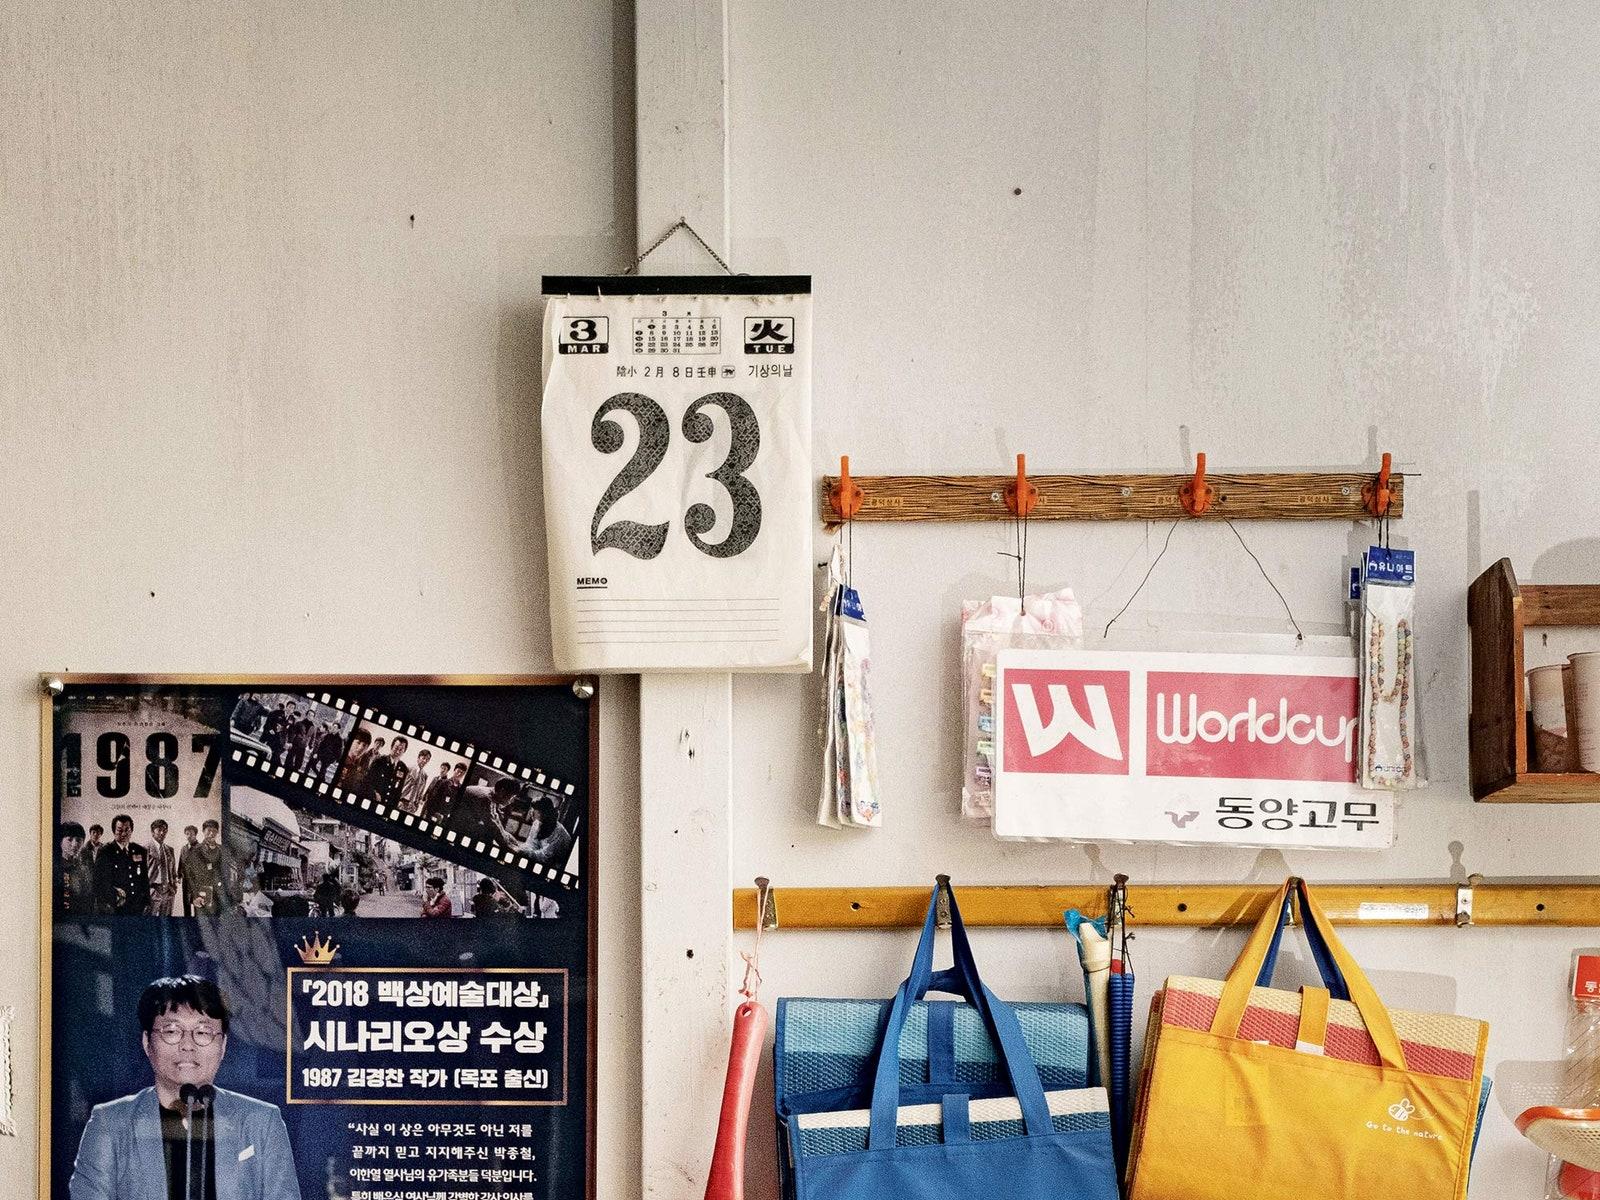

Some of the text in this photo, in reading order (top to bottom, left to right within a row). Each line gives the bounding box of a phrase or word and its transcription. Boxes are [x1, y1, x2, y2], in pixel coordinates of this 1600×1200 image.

[570, 319, 597, 341] 3
[750, 319, 789, 341] 火
[567, 345, 601, 353] MAR
[753, 345, 786, 353] TUE
[748, 365, 793, 378] 기상의날
[591, 391, 762, 561] 23
[576, 577, 608, 586] MEMO
[61, 732, 222, 798] 1987
[1216, 796, 1380, 831] 동양고무
[378, 981, 549, 1009] 백상예술대상』
[303, 1020, 548, 1054] 시나리오상 수상
[302, 1068, 342, 1088] 1987
[347, 1068, 405, 1088] 김경찬
[410, 1069, 447, 1089] 작가
[384, 1123, 396, 1137] 이
[400, 1123, 424, 1137] 상은
[427, 1123, 476, 1137] 아무것도
[480, 1124, 504, 1137] 아닌
[508, 1124, 533, 1138] 저를
[1366, 1121, 1379, 1130] Go
[1396, 1126, 1410, 1135] the
[1413, 1131, 1443, 1141] nature
[352, 1145, 536, 1160] 끝까지 믿고 지지해주신 박종철,
[349, 1168, 537, 1183] 이한열 열사님의 유가족분들 덕분입니다.
